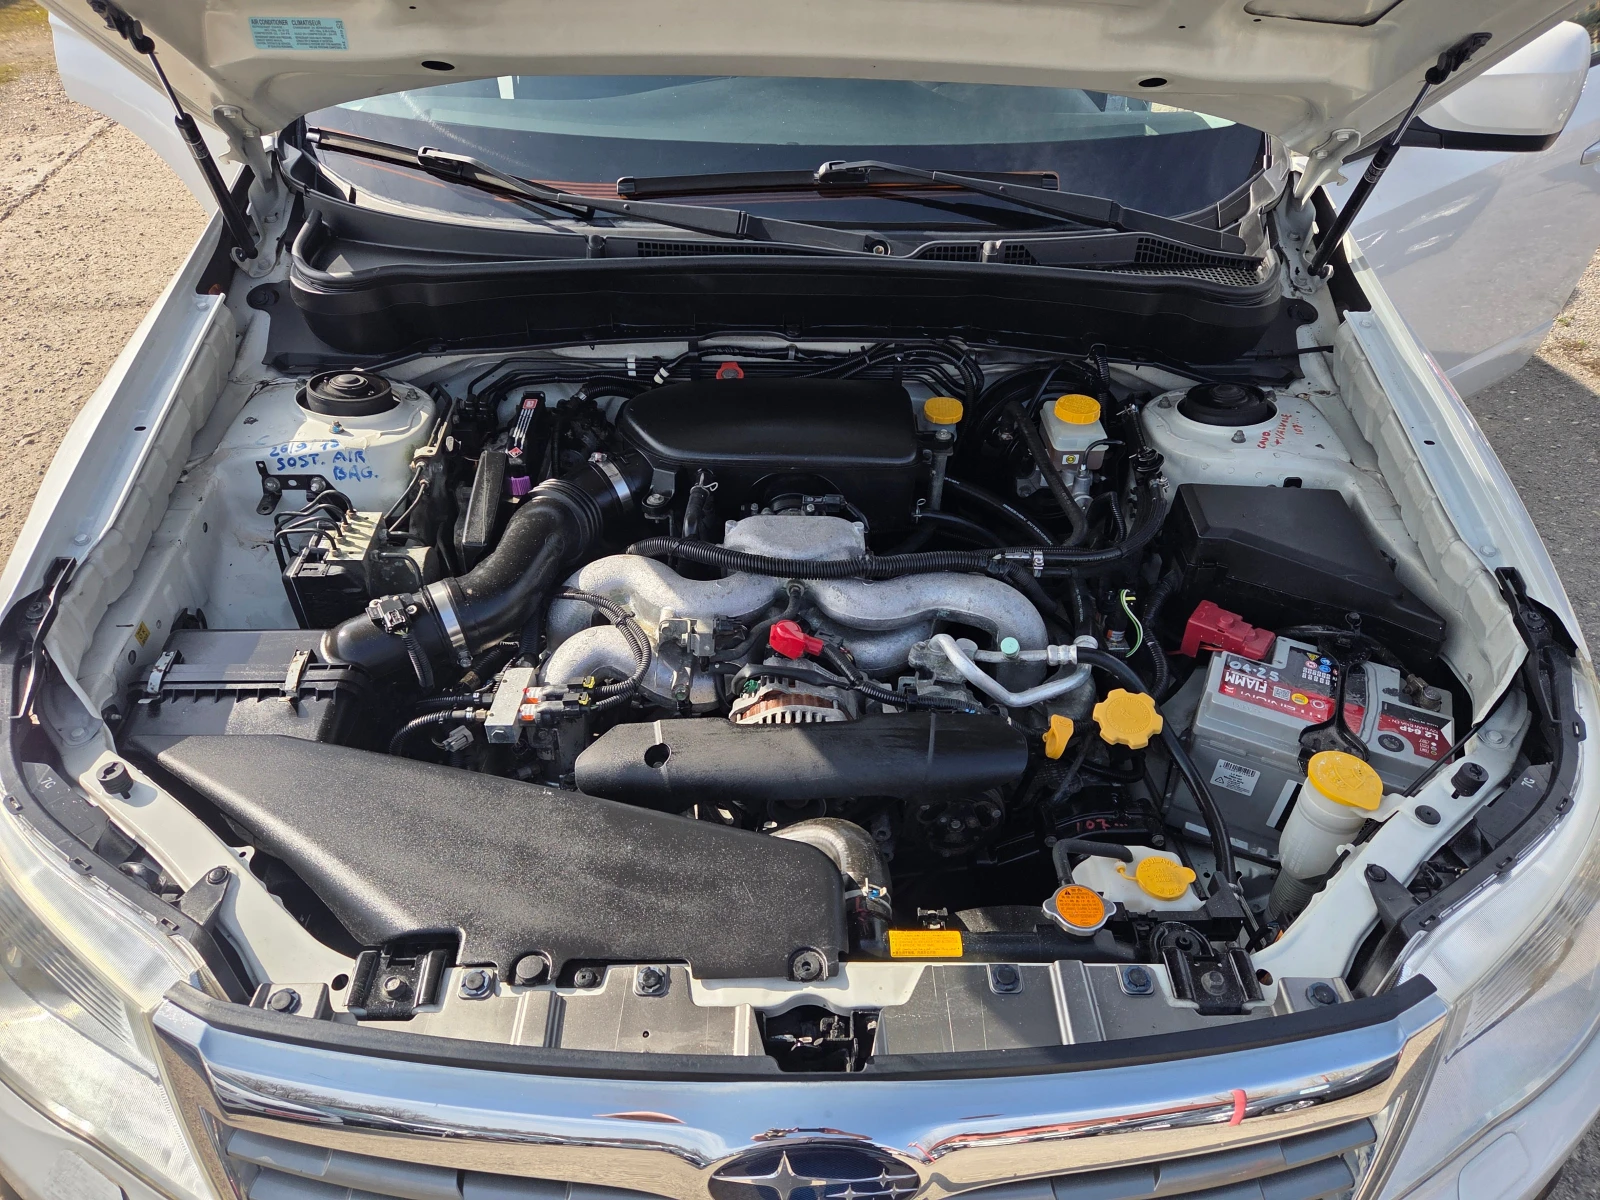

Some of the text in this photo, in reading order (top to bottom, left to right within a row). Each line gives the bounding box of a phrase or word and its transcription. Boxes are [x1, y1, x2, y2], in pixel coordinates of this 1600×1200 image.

[276, 450, 366, 471] SOST. AIR
[332, 465, 379, 482] BAG.
[1224, 671, 1268, 694] FIAMM
